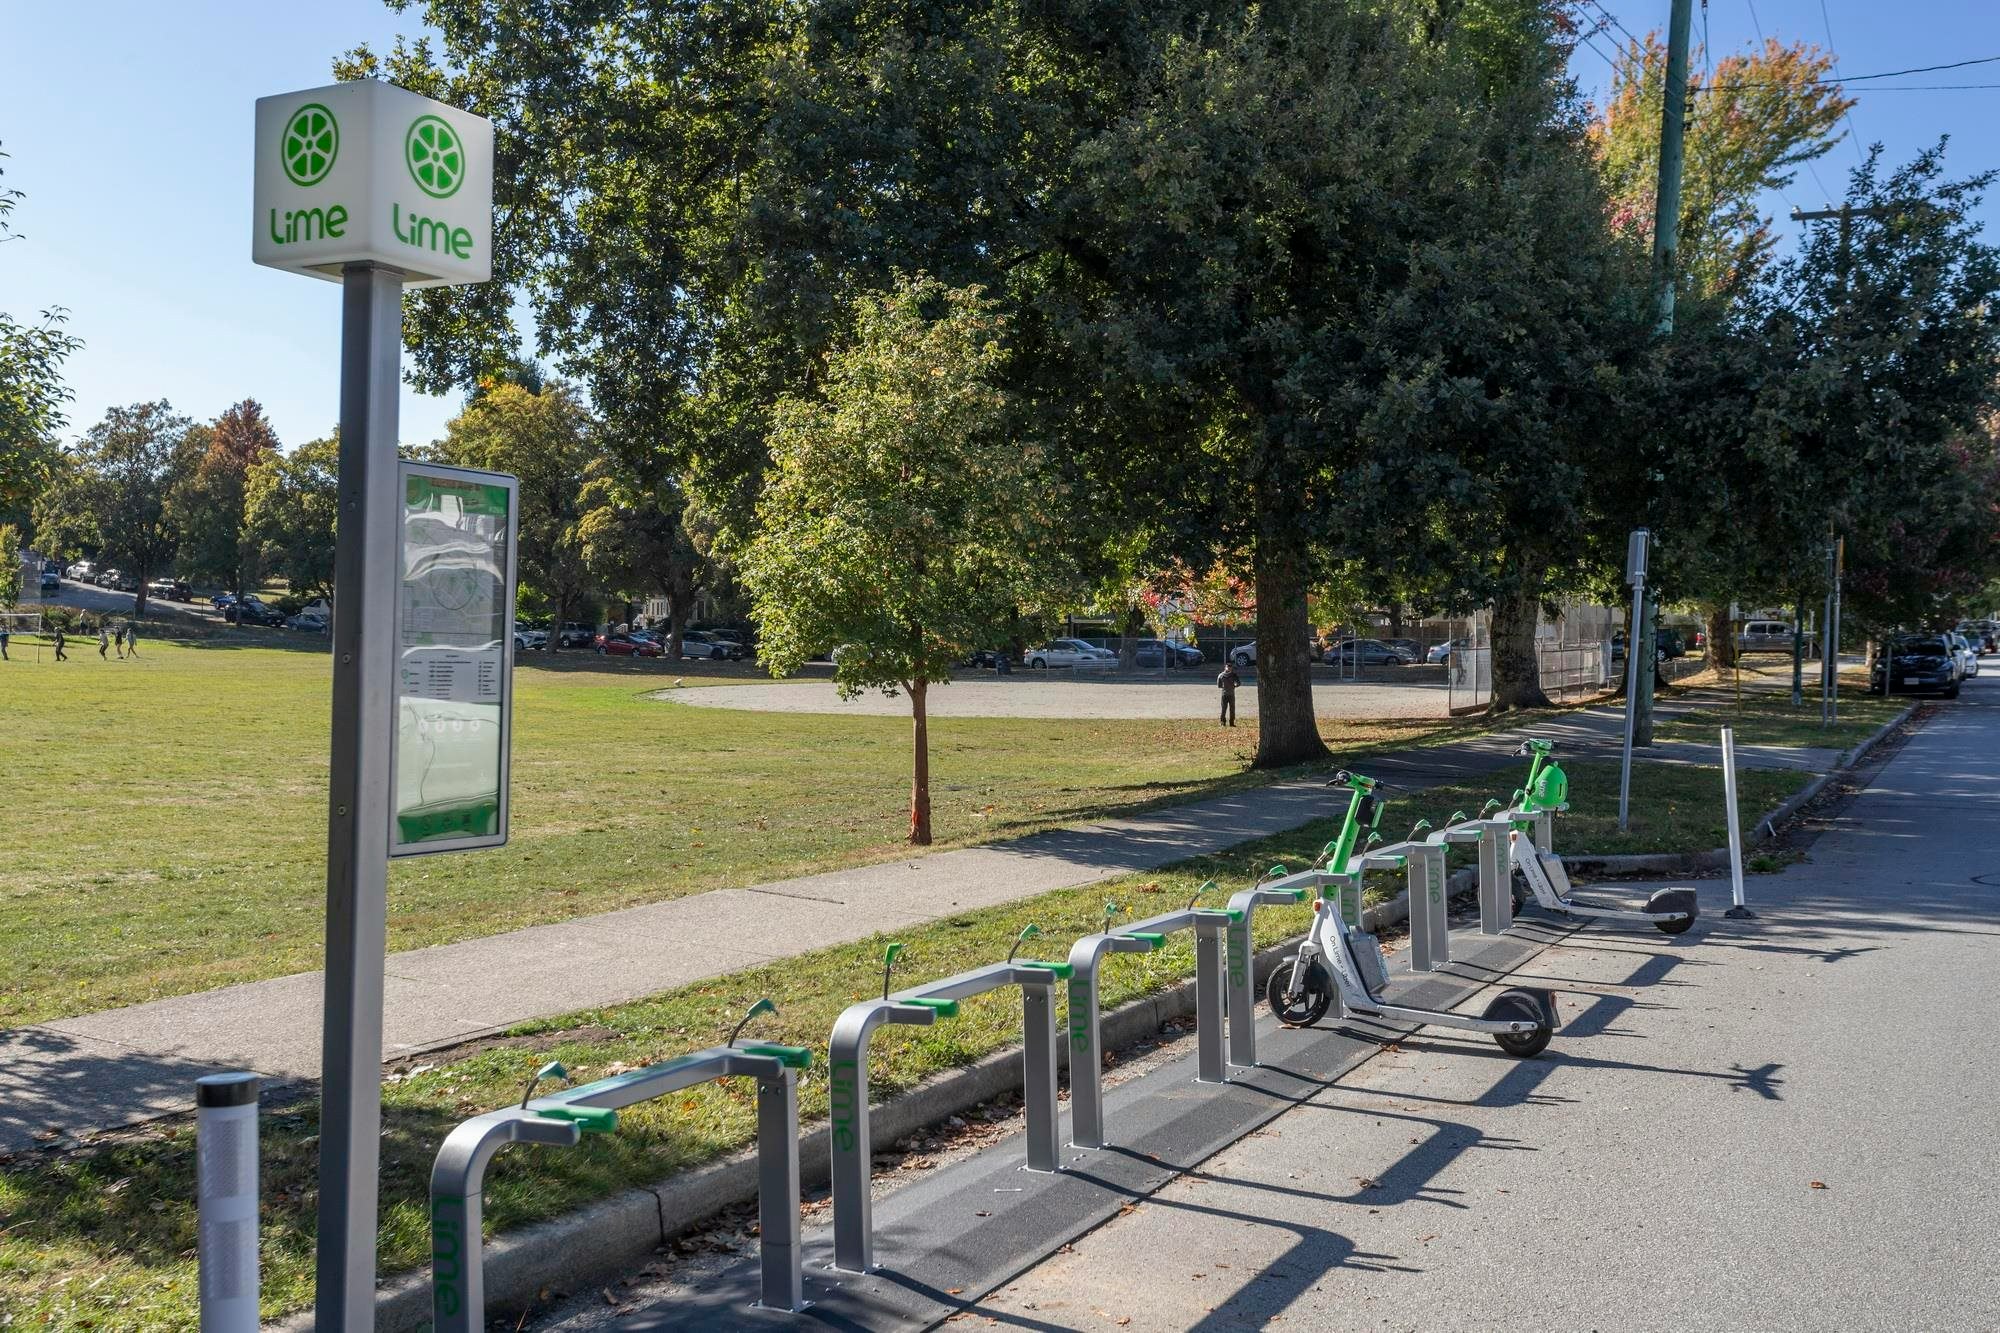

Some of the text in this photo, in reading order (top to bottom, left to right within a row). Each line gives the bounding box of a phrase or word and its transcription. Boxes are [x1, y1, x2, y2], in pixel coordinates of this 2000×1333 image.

[271, 205, 348, 244] Lime
[393, 203, 473, 259] Lime
[1341, 886, 1359, 924] Lim
[1229, 928, 1245, 988] Lime
[1069, 981, 1088, 1053] Lime
[832, 1062, 855, 1151] Lime
[433, 1195, 464, 1317] Lime
